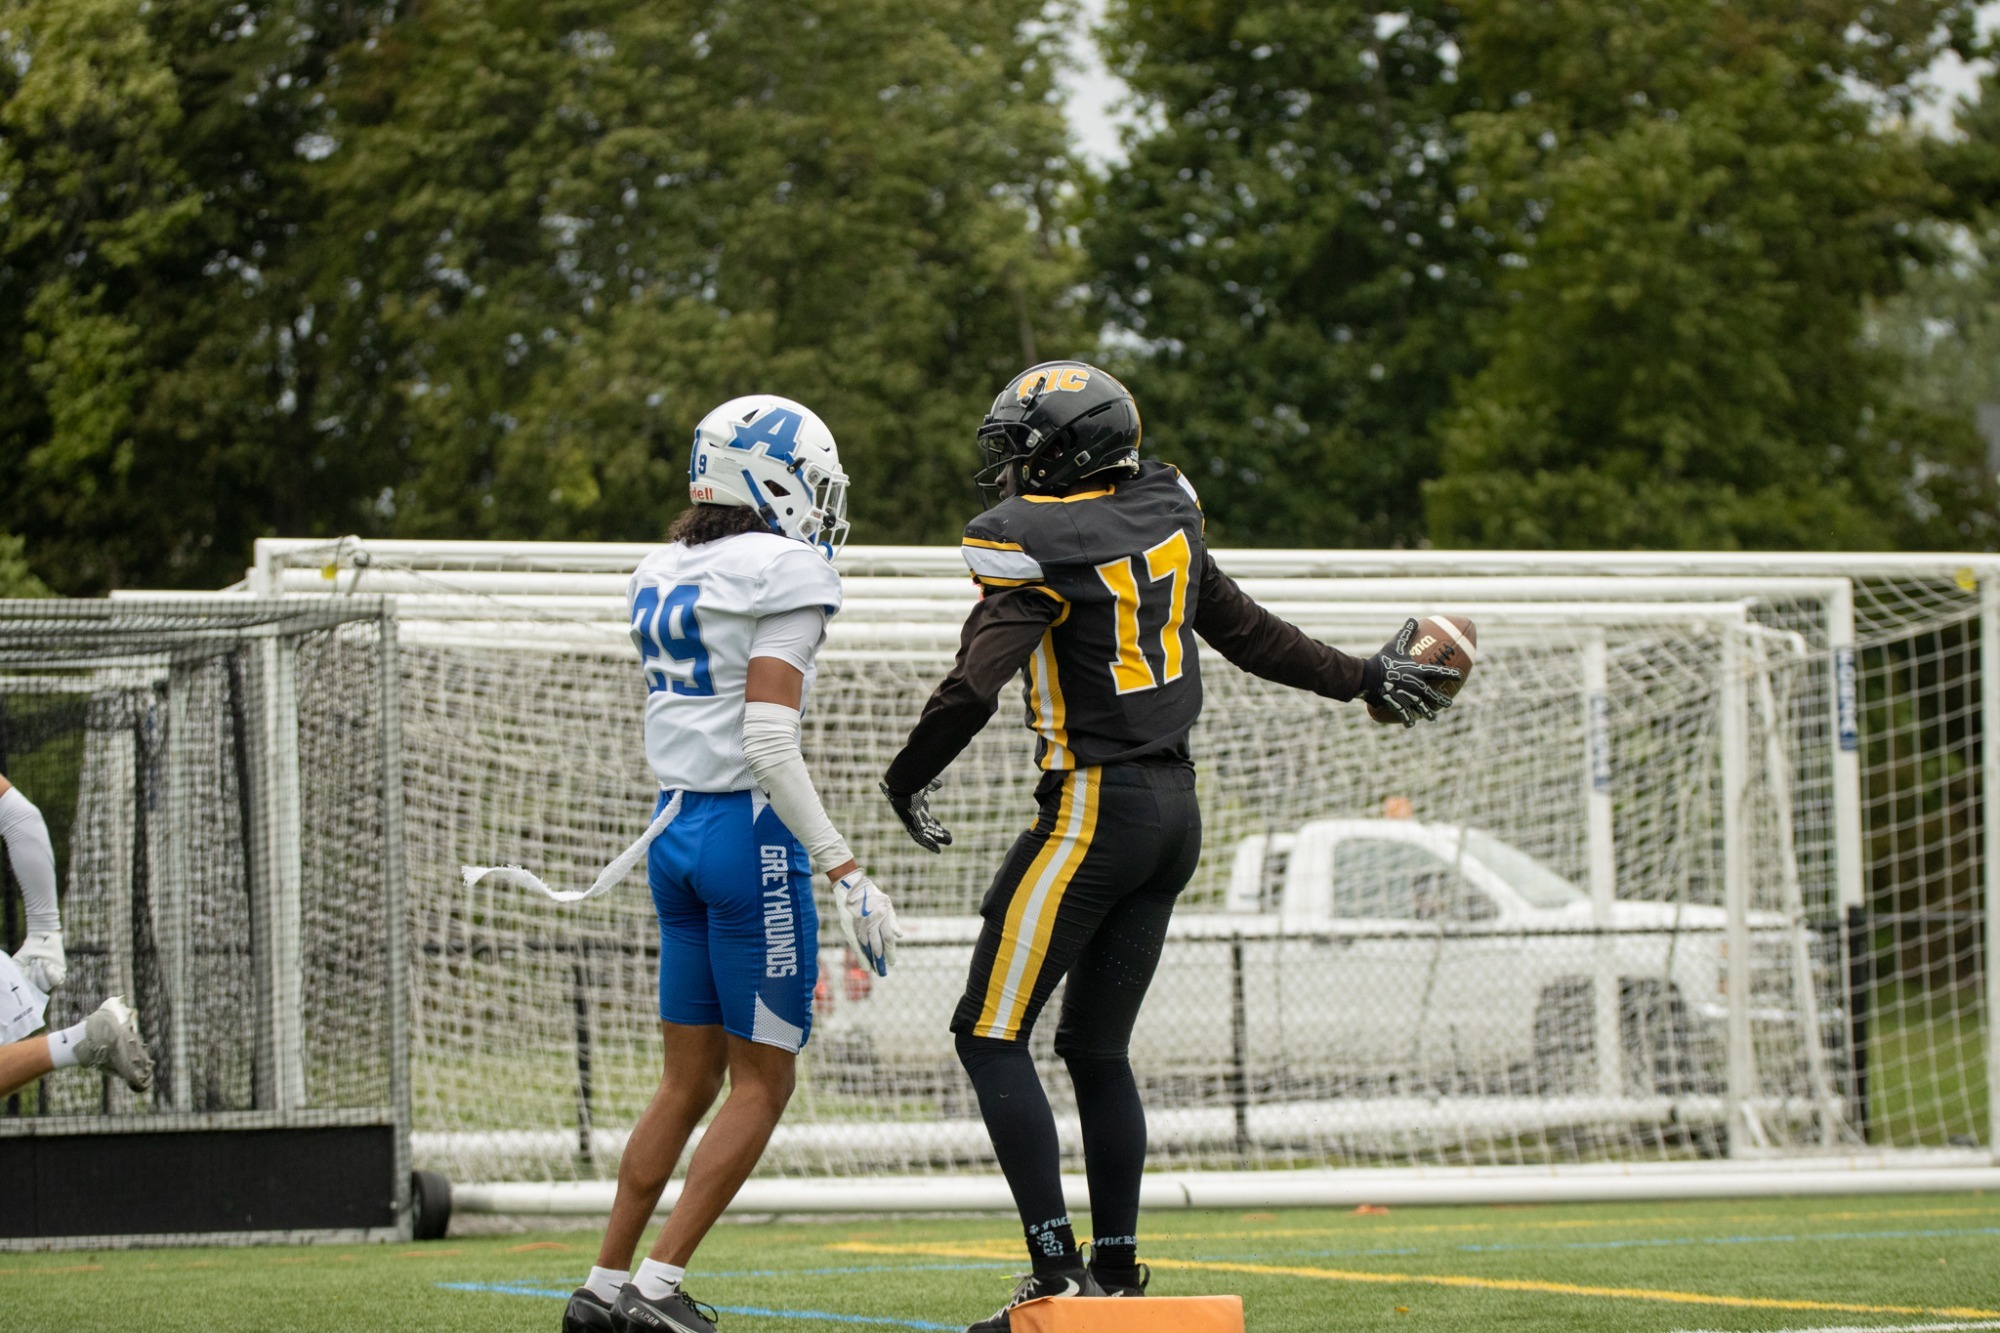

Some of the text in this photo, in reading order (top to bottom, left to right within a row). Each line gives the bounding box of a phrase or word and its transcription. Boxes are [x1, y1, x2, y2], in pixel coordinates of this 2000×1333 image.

[1016, 368, 1091, 400] AIC
[689, 486, 713, 500] dell
[698, 453, 707, 474] 9
[631, 584, 716, 697] 29
[1094, 528, 1191, 696] 17
[760, 844, 798, 979] GREYHOUNDS
